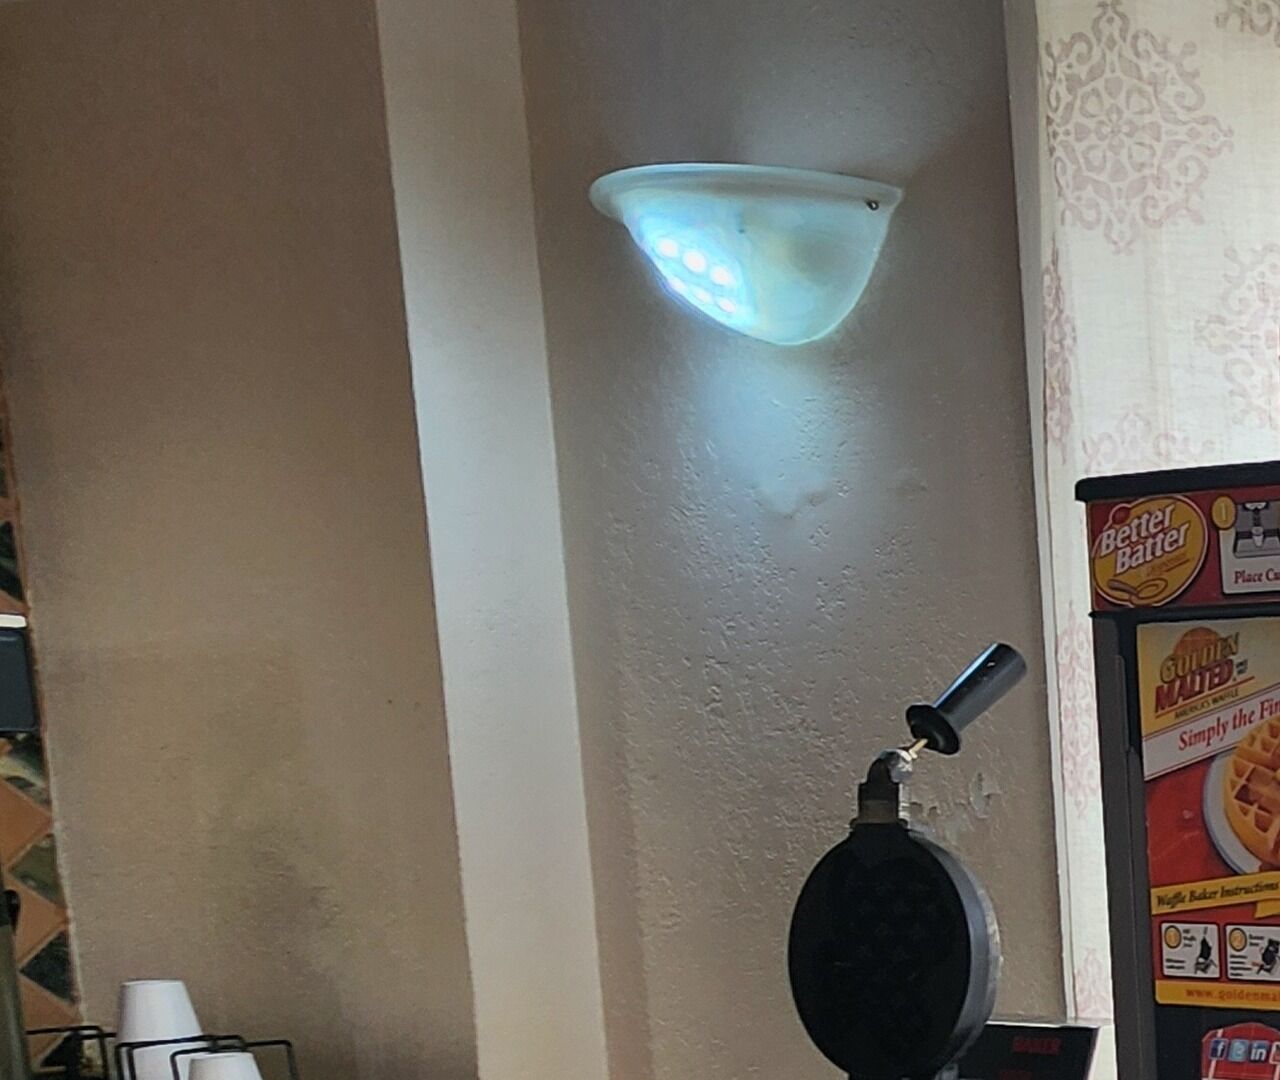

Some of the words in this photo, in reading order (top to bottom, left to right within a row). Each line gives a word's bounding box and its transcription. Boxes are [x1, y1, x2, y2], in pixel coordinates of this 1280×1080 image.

[1100, 504, 1175, 558] Better
[1115, 523, 1190, 575] Batter
[1234, 569, 1263, 585] Place
[1155, 659, 1234, 713] MALTED
[1178, 717, 1228, 751] Simply
[1232, 707, 1256, 731] the
[1156, 892, 1186, 908] Waffle
[1188, 887, 1219, 903] Baker
[1220, 879, 1280, 898] Instructions
